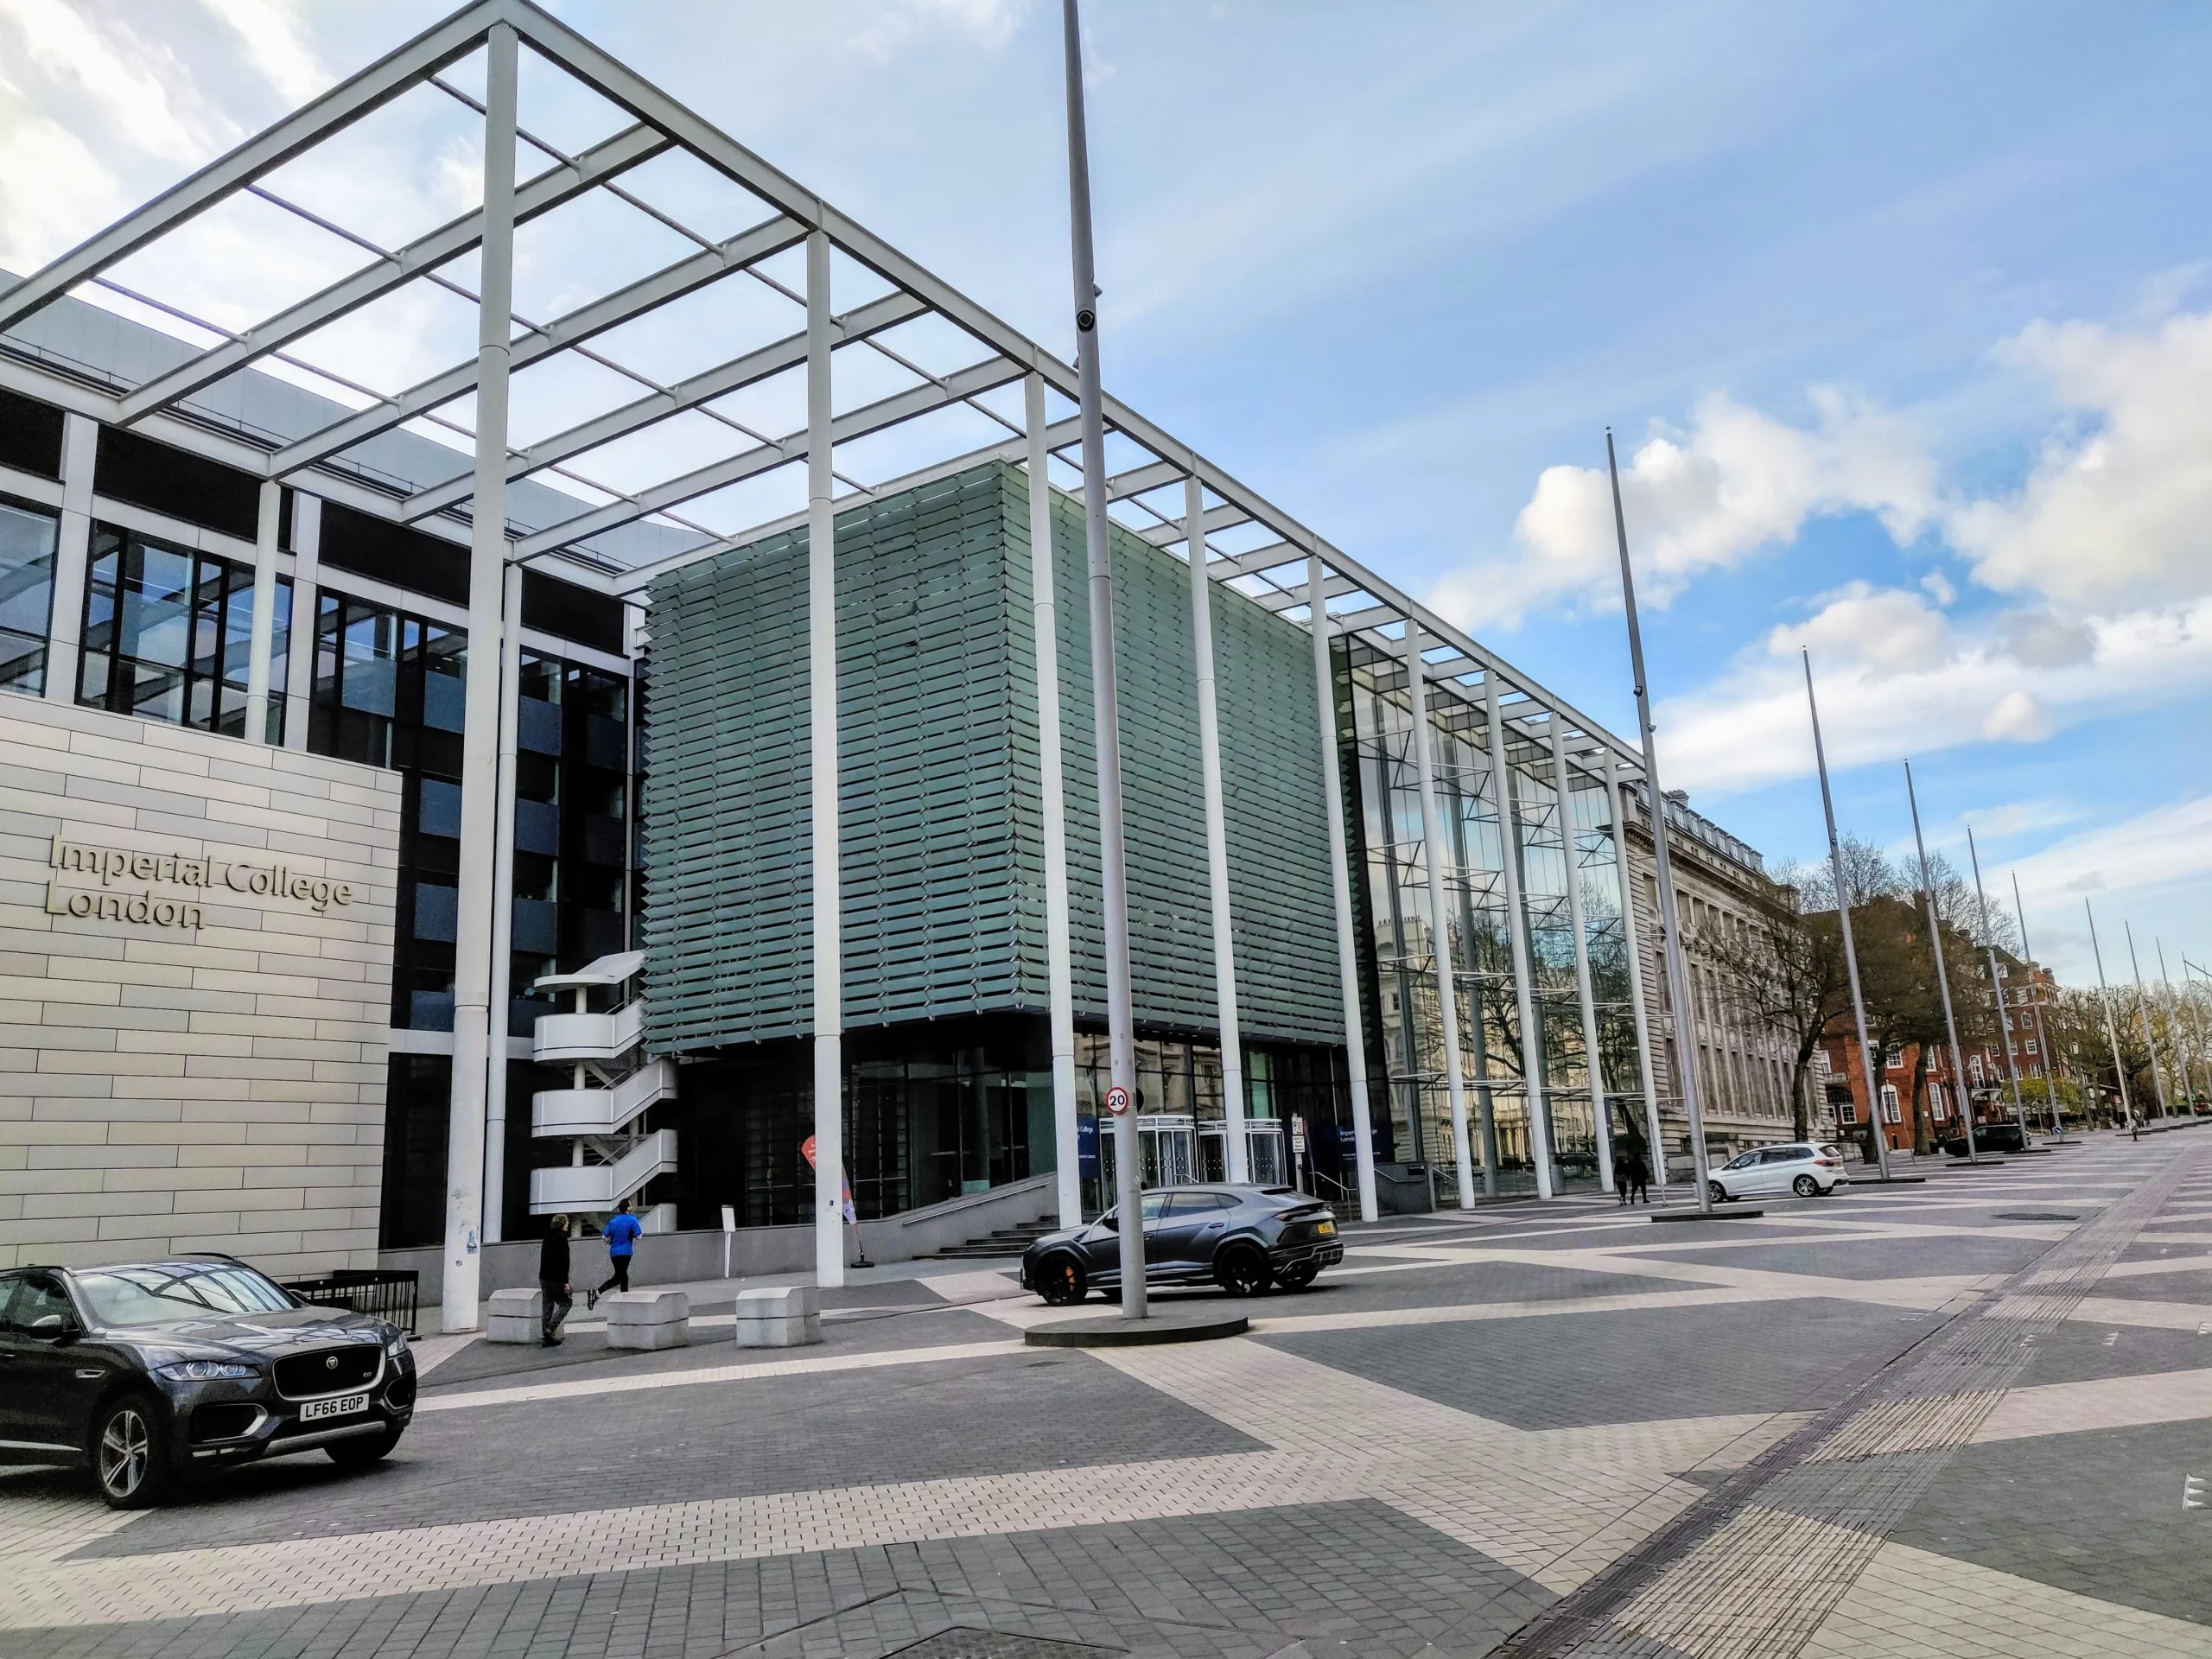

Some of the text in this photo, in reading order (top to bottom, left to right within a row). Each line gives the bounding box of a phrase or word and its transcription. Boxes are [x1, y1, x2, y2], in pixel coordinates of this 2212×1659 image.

[49, 834, 353, 911] Imperial College
[44, 880, 206, 929] London
[1109, 1095, 1125, 1106] 20
[306, 1396, 364, 1418] LF66 EOP
